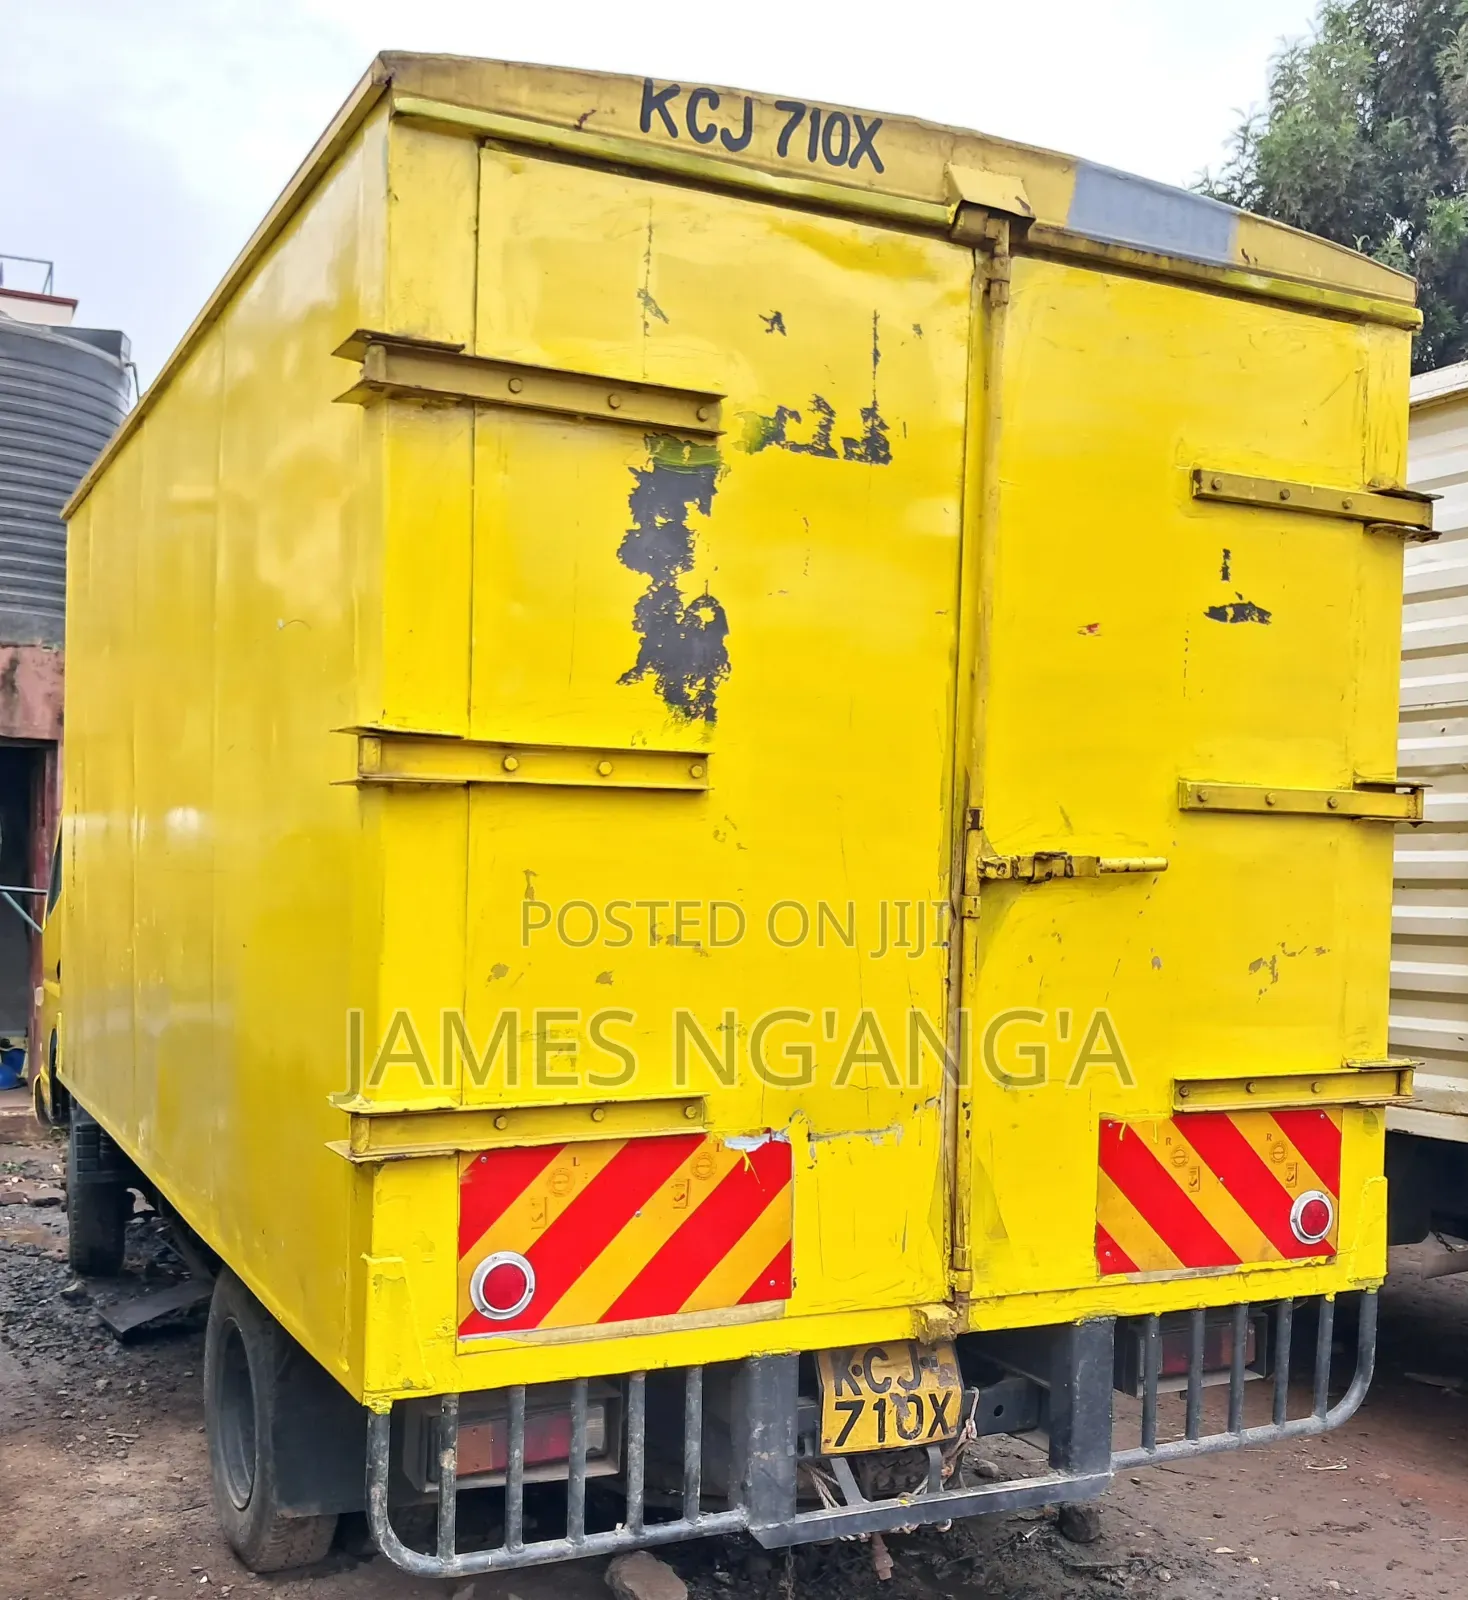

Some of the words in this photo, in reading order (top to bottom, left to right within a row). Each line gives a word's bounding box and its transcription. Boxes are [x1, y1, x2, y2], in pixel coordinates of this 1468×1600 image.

[639, 77, 753, 153] KCJ
[774, 100, 885, 174] 710X
[832, 1343, 922, 1396] KCJ
[834, 1391, 953, 1447] 710X
